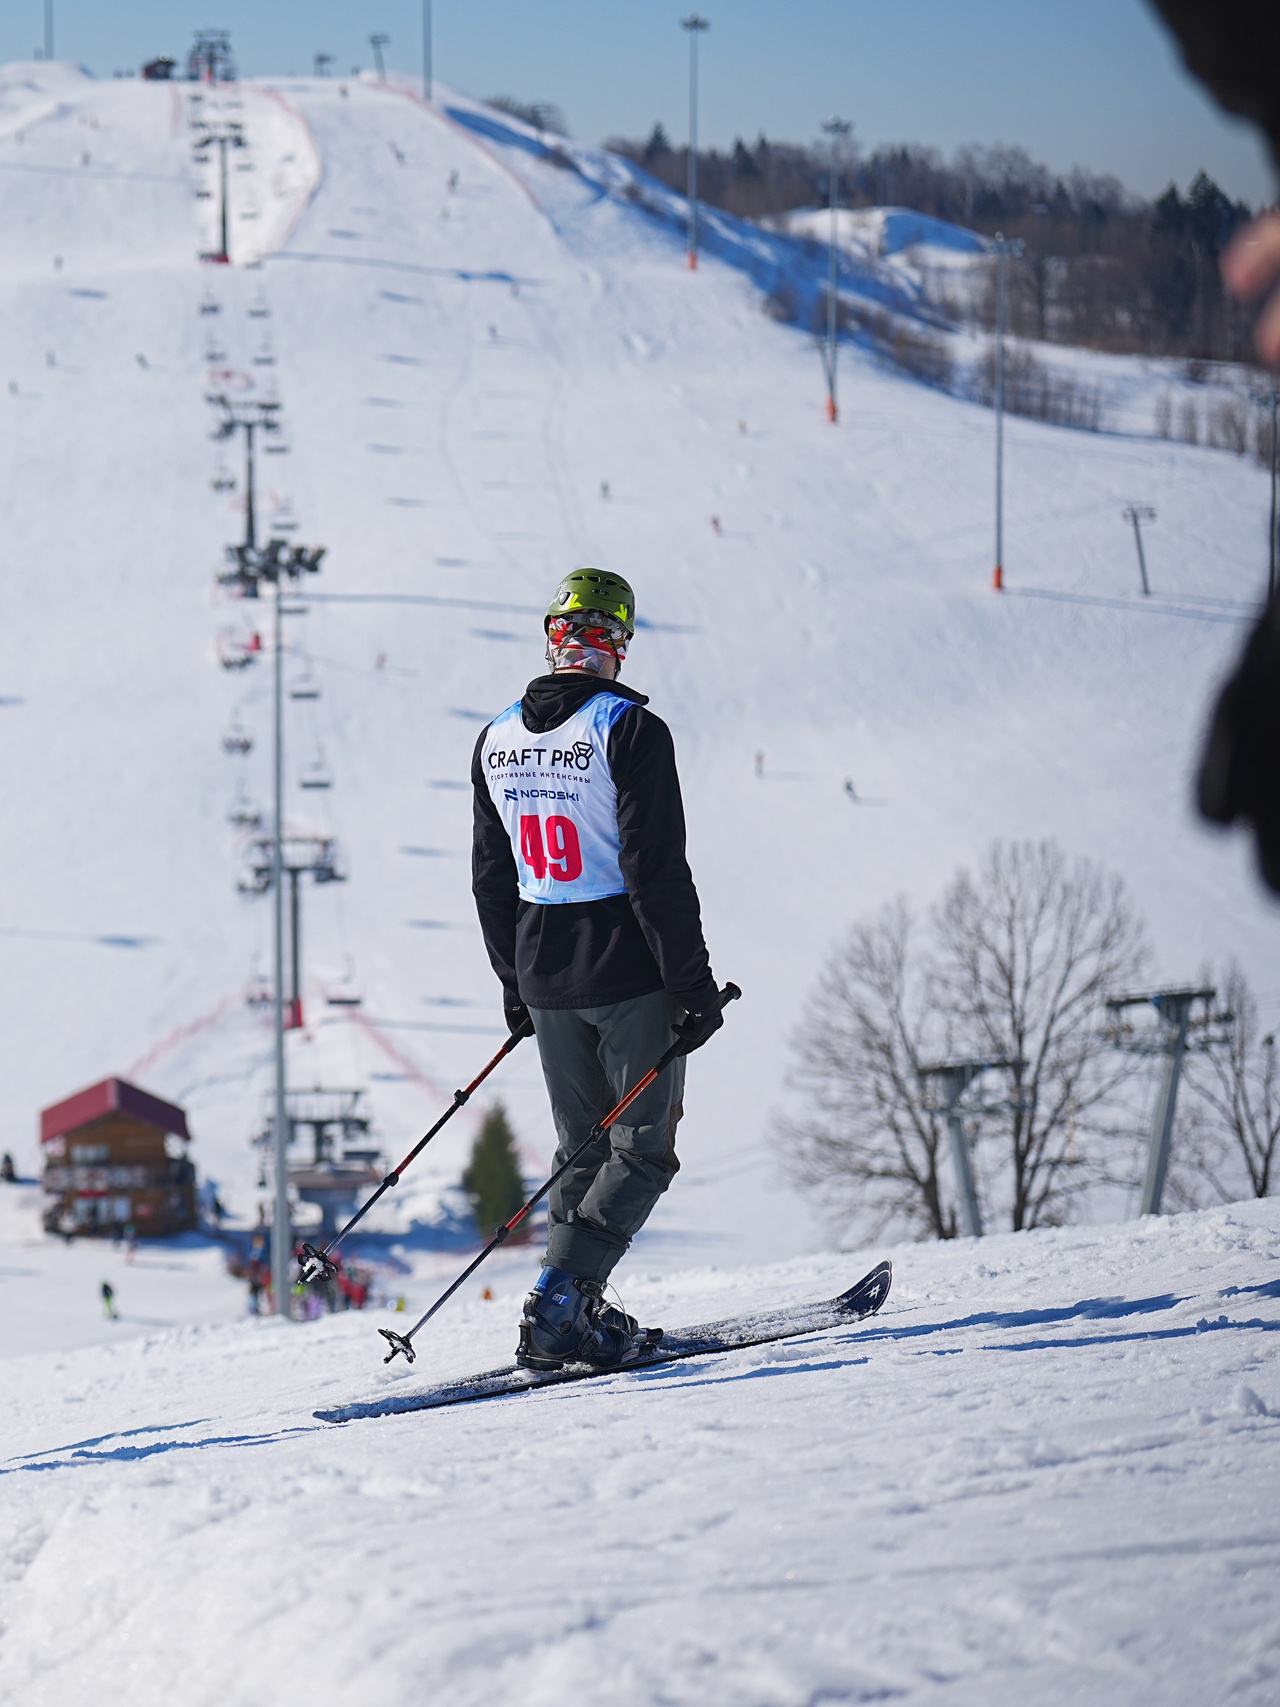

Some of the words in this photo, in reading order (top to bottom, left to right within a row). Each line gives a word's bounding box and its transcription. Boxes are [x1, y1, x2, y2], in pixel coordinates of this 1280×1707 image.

[488, 748, 547, 769] CRAFT
[551, 744, 592, 770] PRO
[540, 772, 591, 784] ИНТЕНСИВЫ
[520, 789, 580, 801] NORDSKI
[520, 814, 583, 882] 49
